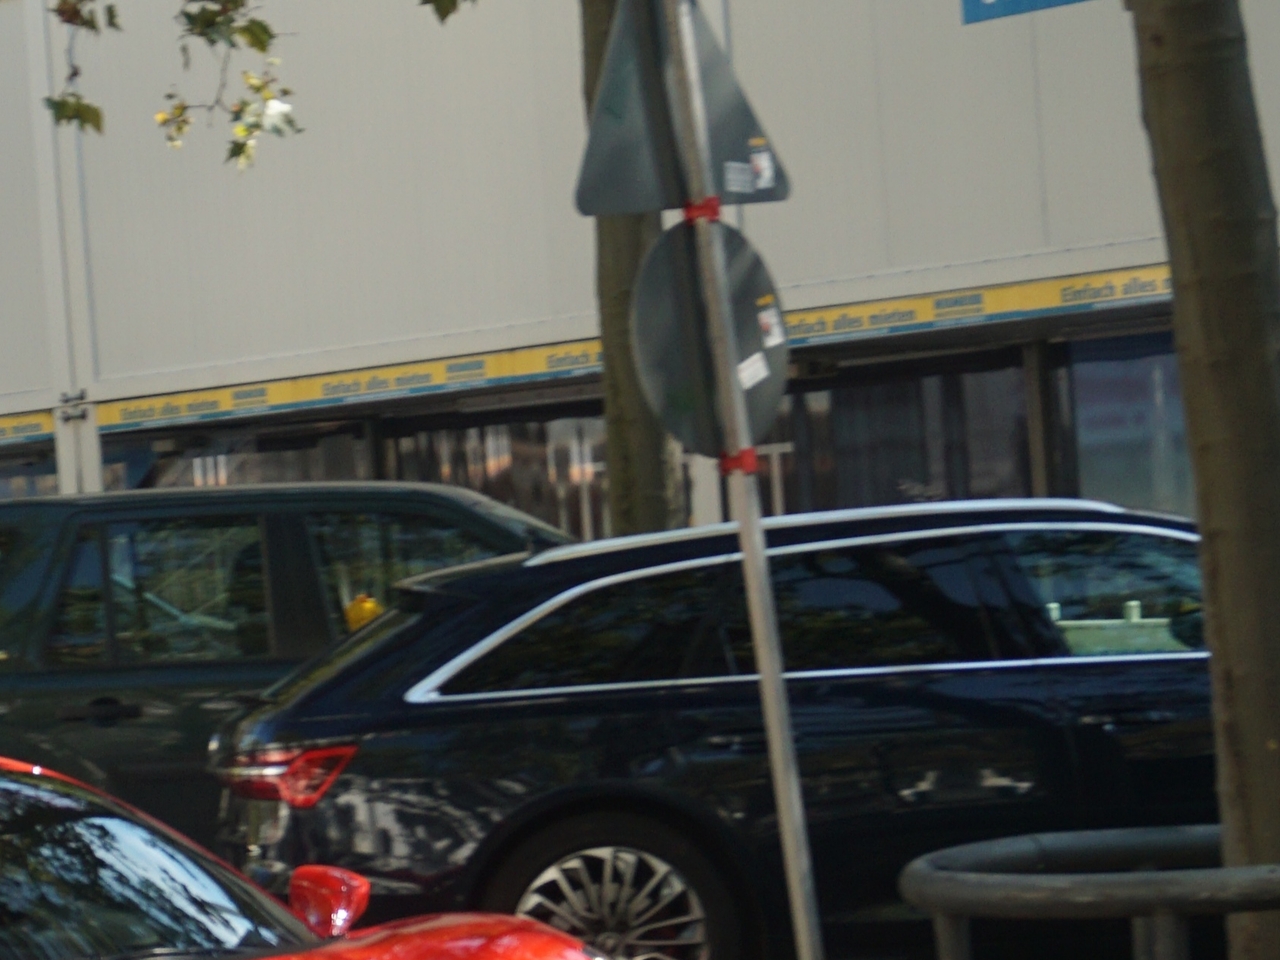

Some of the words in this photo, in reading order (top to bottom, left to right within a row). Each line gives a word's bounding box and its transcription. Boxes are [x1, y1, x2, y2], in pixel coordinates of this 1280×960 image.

[1061, 283, 1115, 302] Einfach
[1122, 276, 1157, 295] alles
[833, 313, 863, 331] alles
